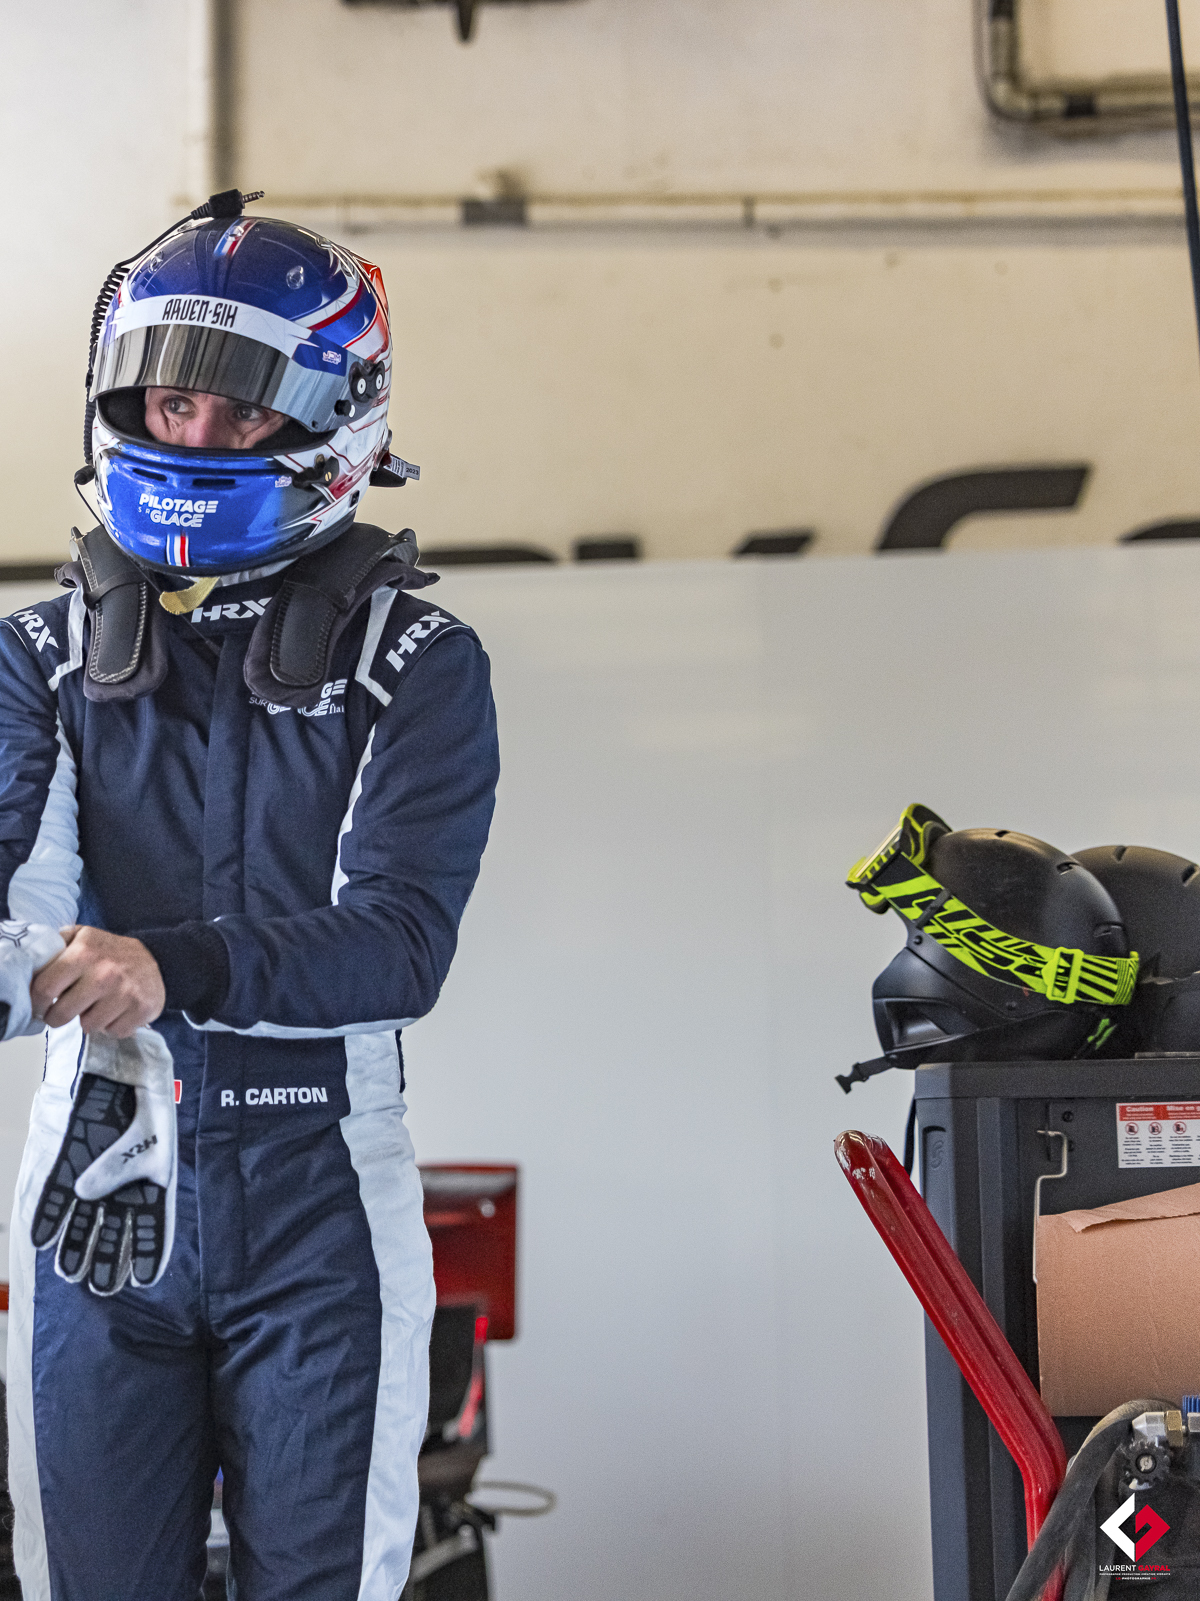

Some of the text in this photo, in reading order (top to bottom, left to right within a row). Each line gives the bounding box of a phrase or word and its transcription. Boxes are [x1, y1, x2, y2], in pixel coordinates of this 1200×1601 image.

[139, 493, 219, 513] PILOTAGE
[150, 509, 204, 528] GLACE
[191, 596, 273, 623] HRX
[13, 609, 59, 652] HRX
[385, 610, 451, 672] HRX
[220, 1086, 329, 1107] R. CARTON
